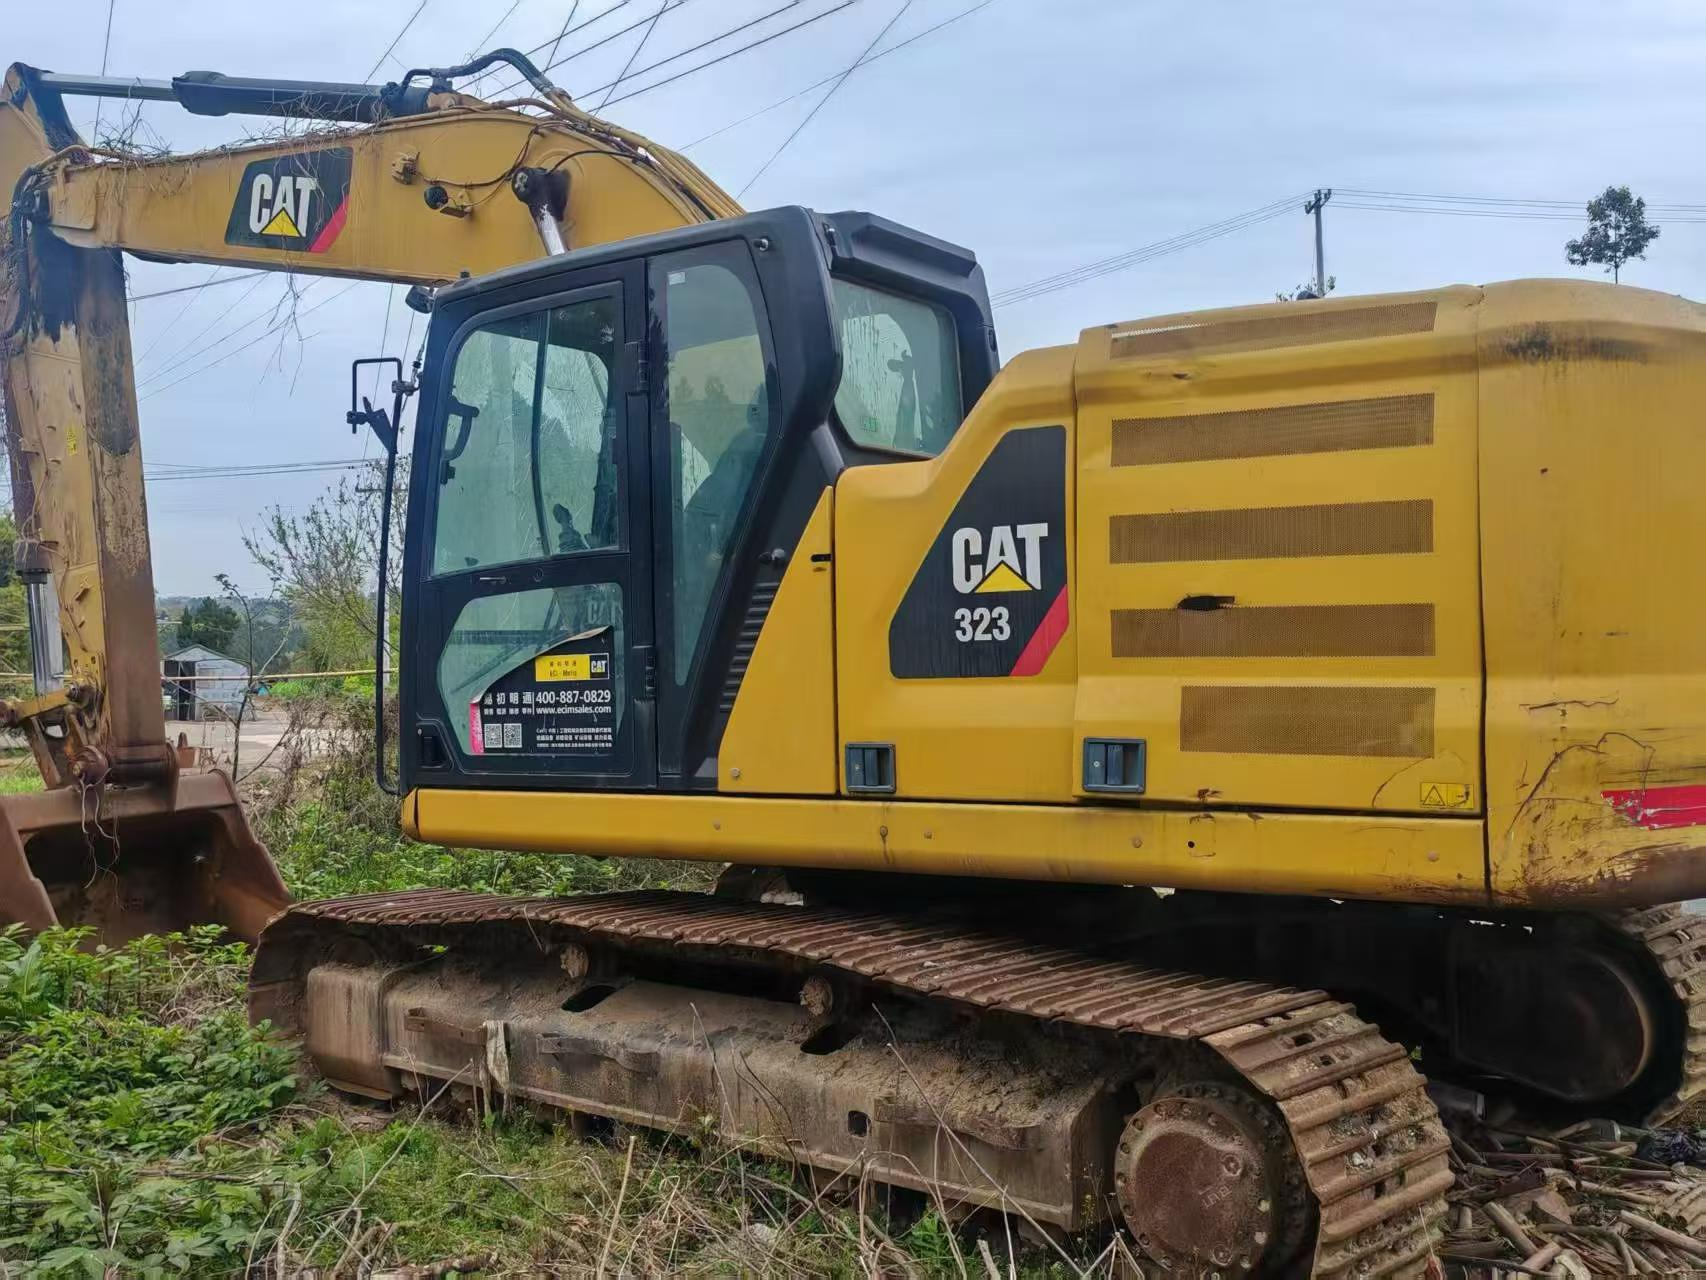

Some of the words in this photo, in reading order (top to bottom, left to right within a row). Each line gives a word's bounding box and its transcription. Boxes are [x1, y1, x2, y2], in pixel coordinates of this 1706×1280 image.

[249, 173, 318, 237] CAT
[952, 522, 1049, 594] CAT
[954, 606, 1011, 642] 323
[591, 660, 608, 672] CAT
[535, 690, 612, 704] 400-887-0829
[535, 704, 612, 715] www.ecimsales.com
